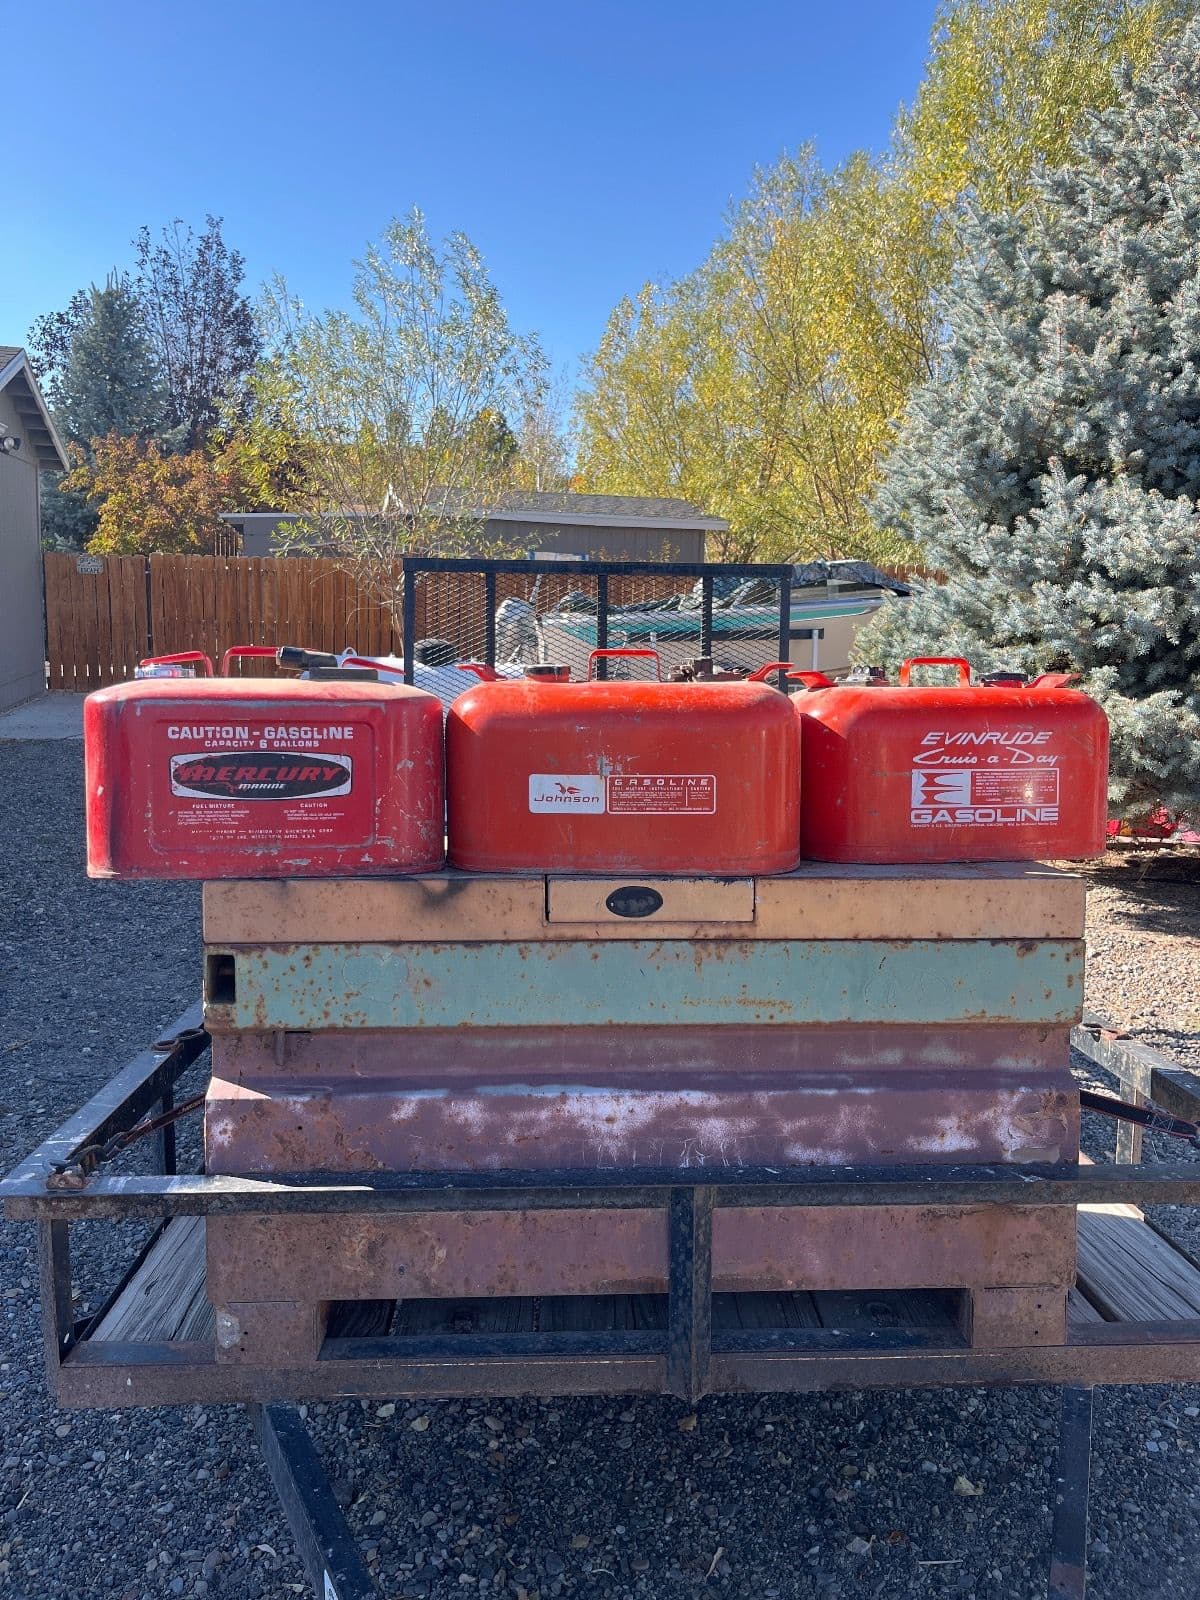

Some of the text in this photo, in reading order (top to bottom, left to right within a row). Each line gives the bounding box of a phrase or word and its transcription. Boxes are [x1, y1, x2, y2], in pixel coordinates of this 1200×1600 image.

[167, 726, 249, 740] CAUTION
[264, 726, 354, 740] GASOLINE
[920, 731, 1053, 745] EVINRUDE
[204, 739, 320, 749] CAPACITY 6 GALLONS
[178, 765, 343, 782] MERCURY
[238, 782, 287, 790] MARINE
[614, 778, 709, 786] GASOLINE
[534, 793, 600, 803] Johnson
[910, 807, 1059, 824] GASOLINE
